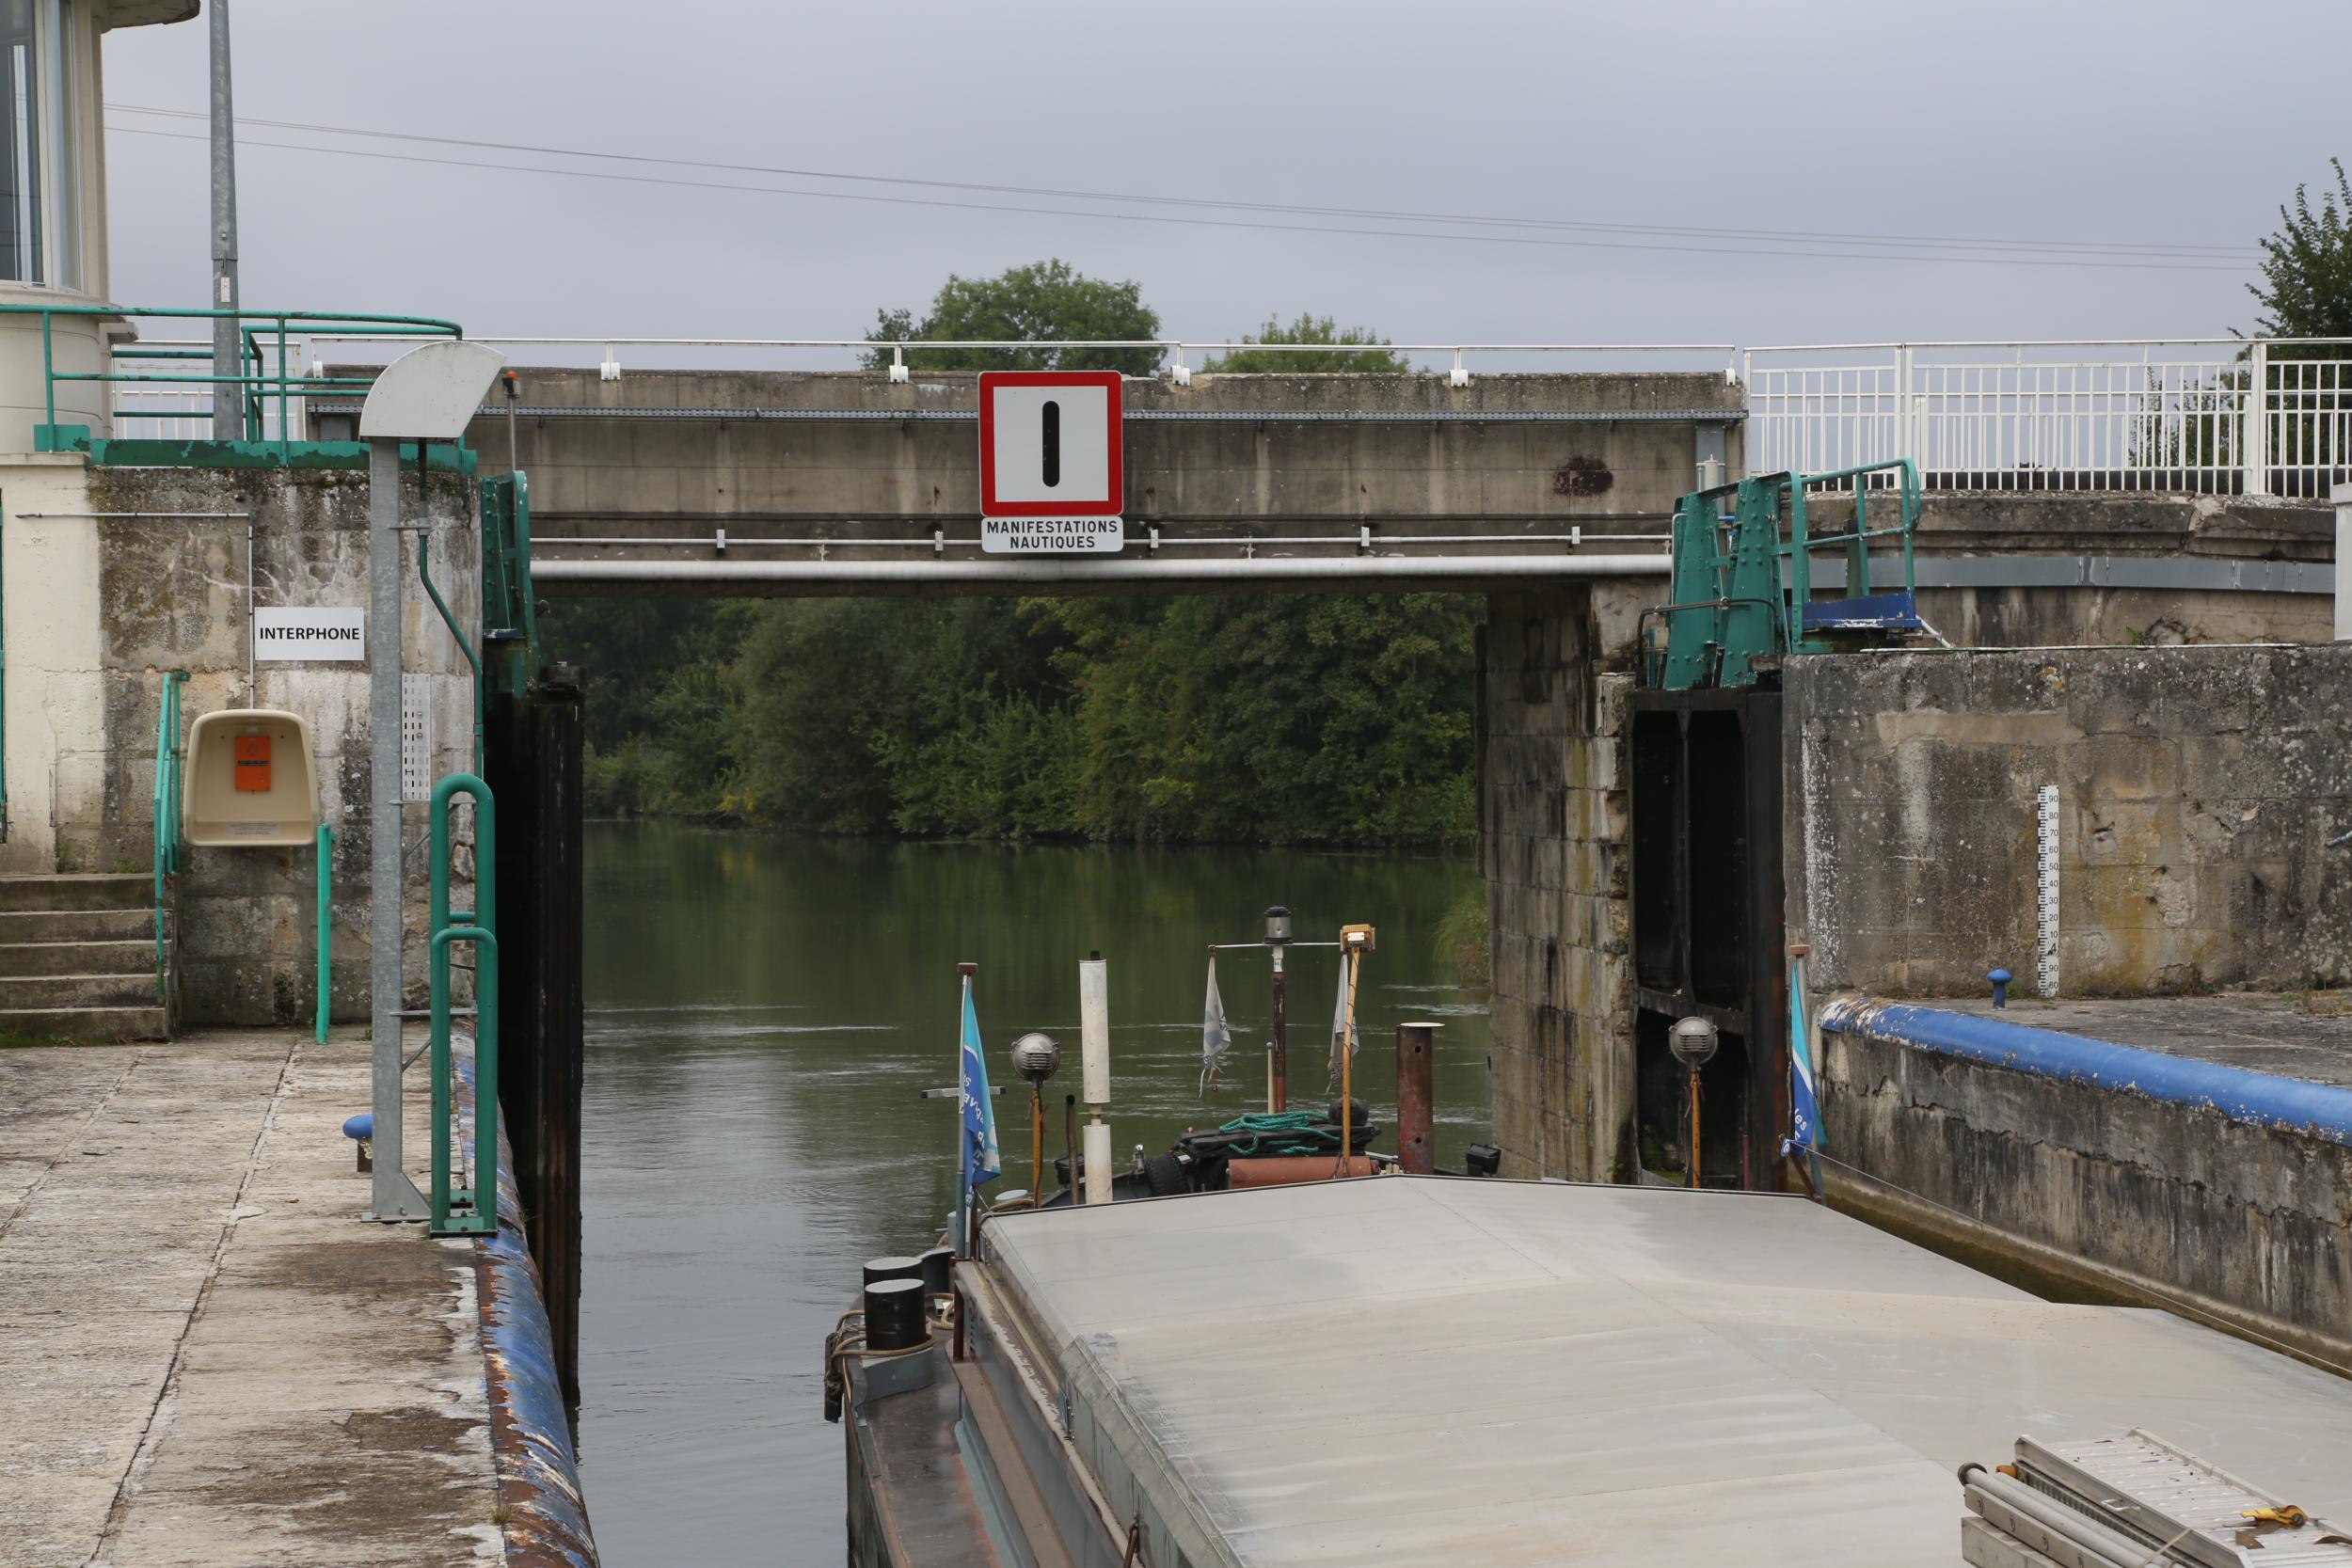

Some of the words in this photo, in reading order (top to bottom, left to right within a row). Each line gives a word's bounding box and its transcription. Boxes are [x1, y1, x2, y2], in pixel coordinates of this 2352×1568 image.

[987, 520, 1118, 533] MANIFESTATIONS
[1009, 535, 1095, 548] NAUTIQUES
[260, 627, 360, 640] INTERPHONE
[2050, 829, 2058, 837] 70
[2049, 846, 2058, 854] 60
[2049, 896, 2058, 905] 30
[2049, 913, 2058, 922] 20
